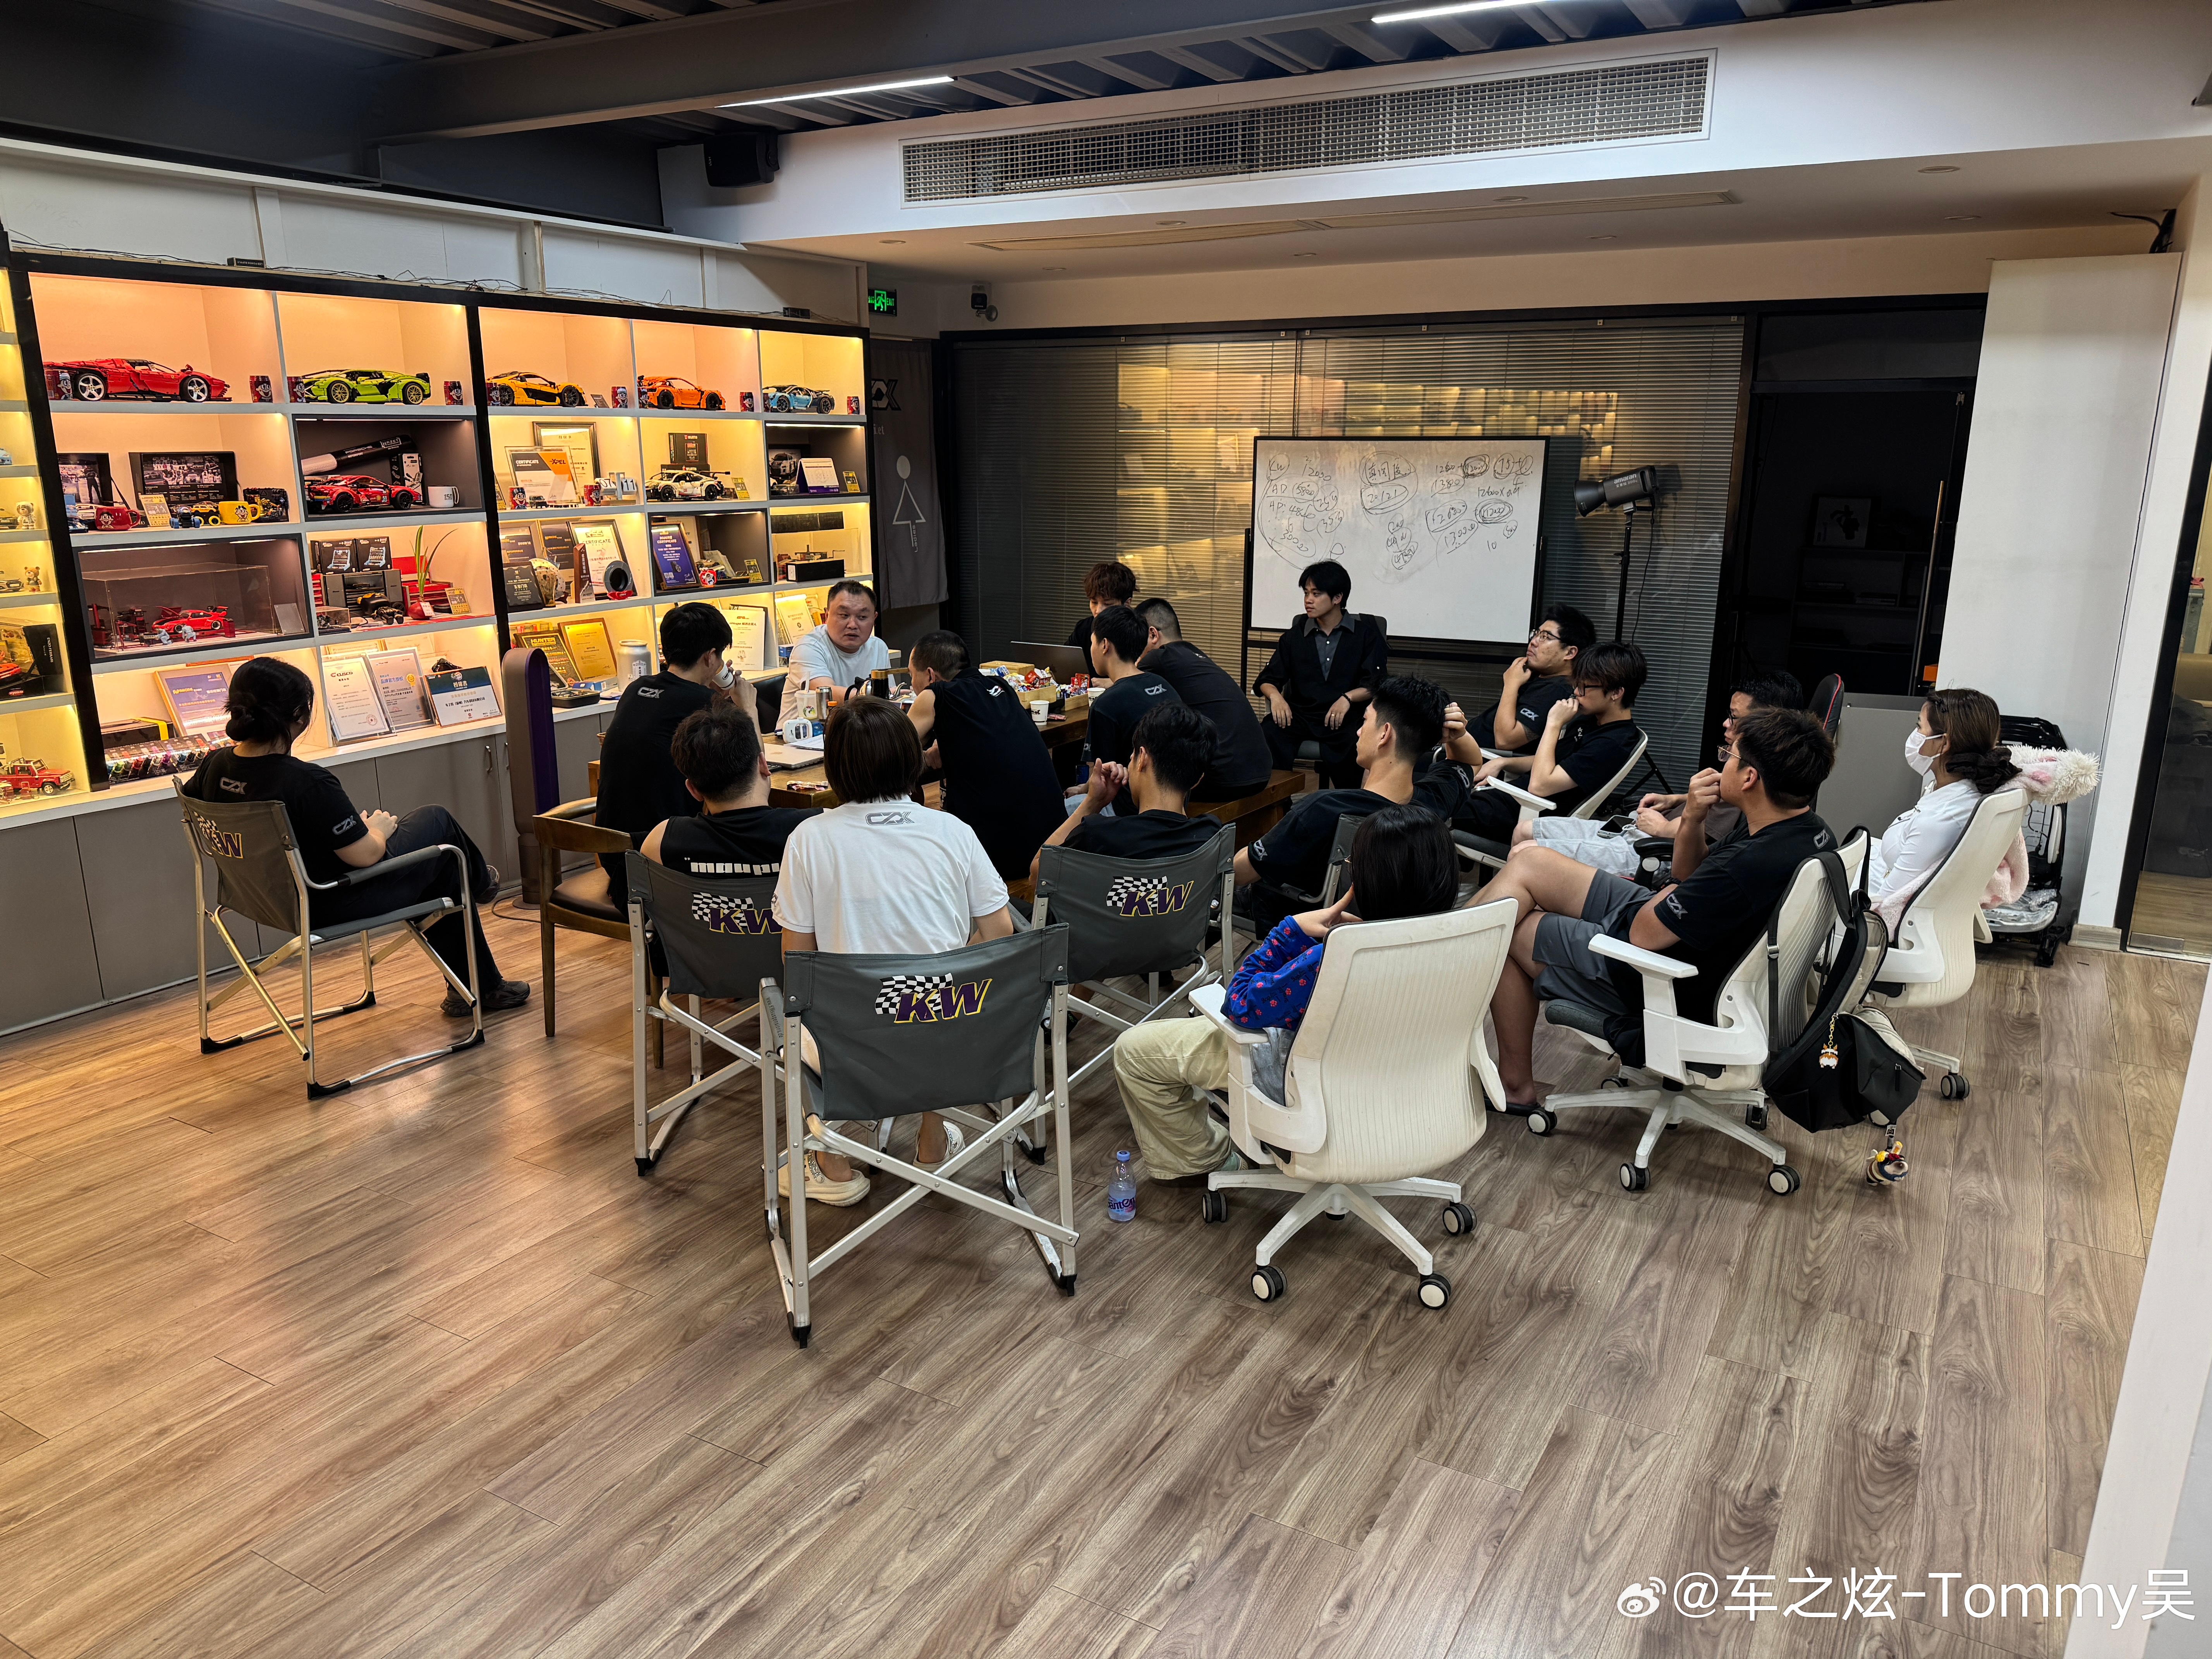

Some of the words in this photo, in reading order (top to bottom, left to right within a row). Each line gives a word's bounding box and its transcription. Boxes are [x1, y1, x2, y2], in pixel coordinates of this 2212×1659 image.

[600, 479, 612, 488] 07
[624, 479, 635, 491] 11
[1614, 474, 1637, 484] amaran
[1120, 880, 1194, 917] KW
[709, 908, 783, 934] KW
[894, 978, 993, 1023] KW
